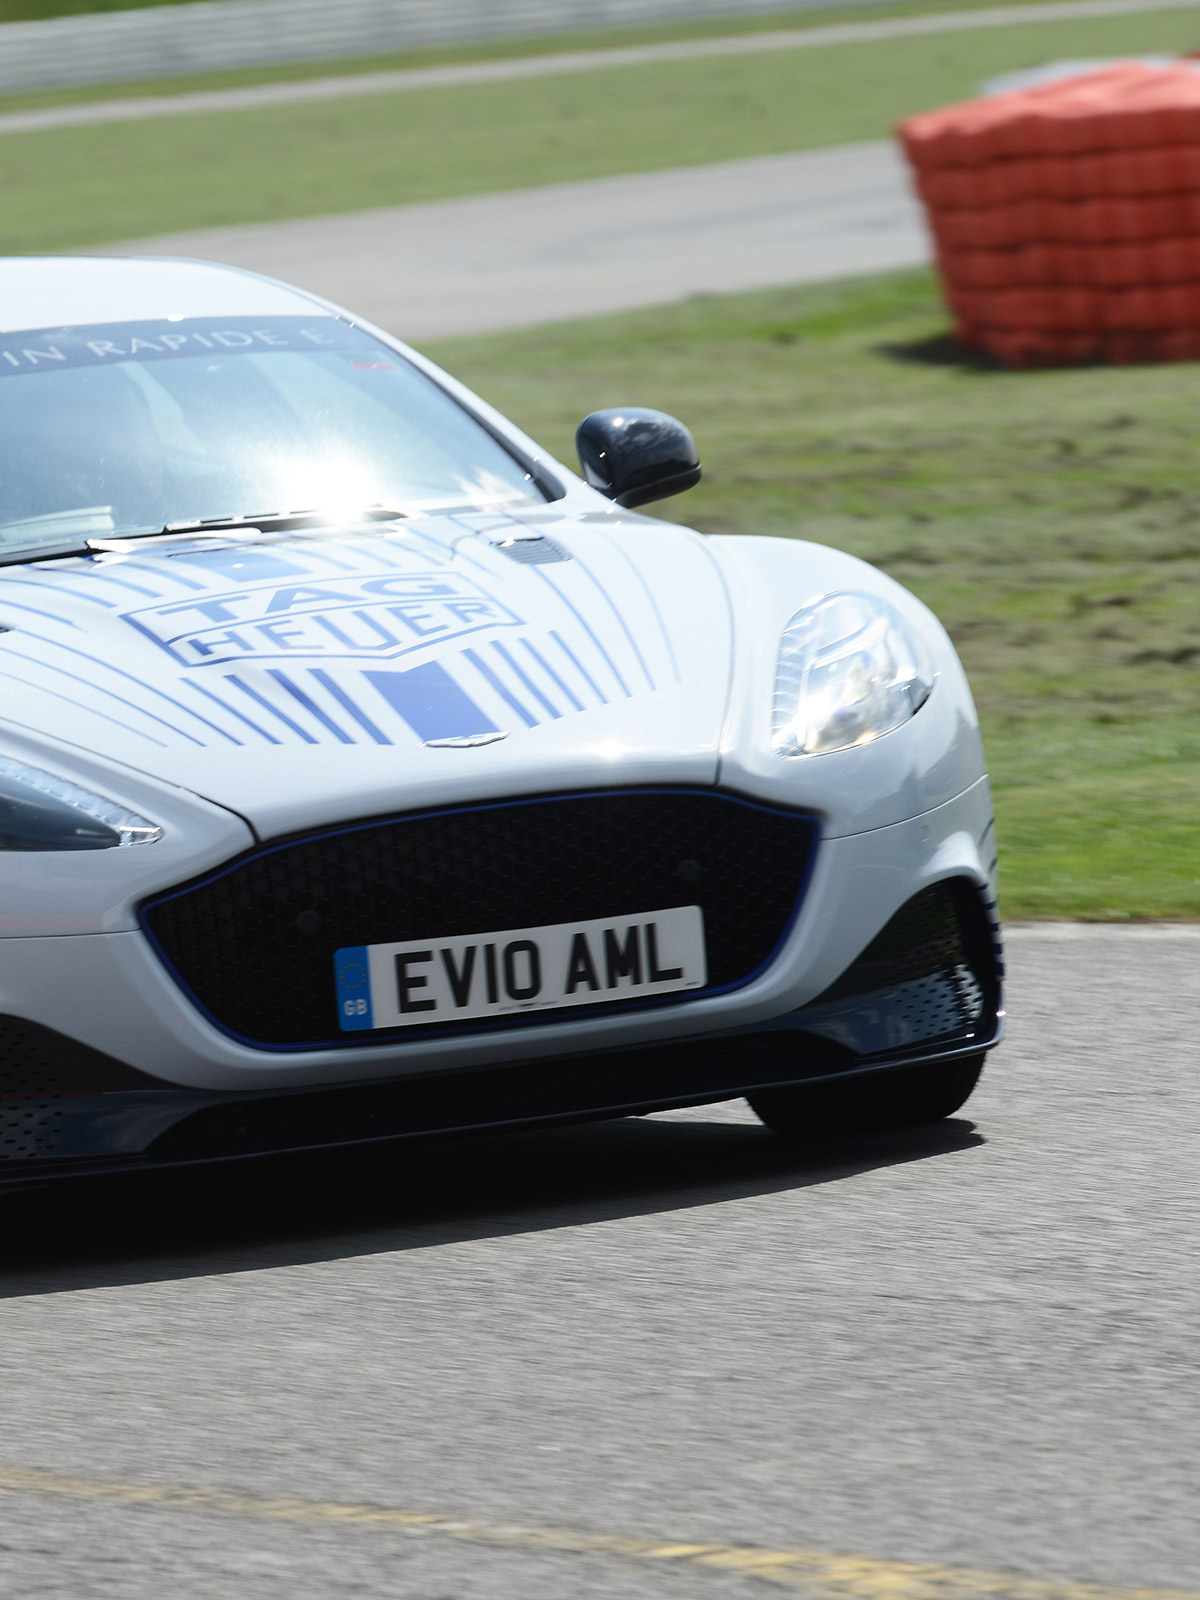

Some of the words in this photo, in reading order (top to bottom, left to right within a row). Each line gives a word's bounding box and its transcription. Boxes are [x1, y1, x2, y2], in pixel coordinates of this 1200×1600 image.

[87, 329, 288, 357] RAPIDE
[299, 328, 336, 345] E
[158, 577, 461, 623] TAG
[185, 602, 502, 657] HEUER
[564, 922, 685, 995] AML
[343, 999, 368, 1017] GB
